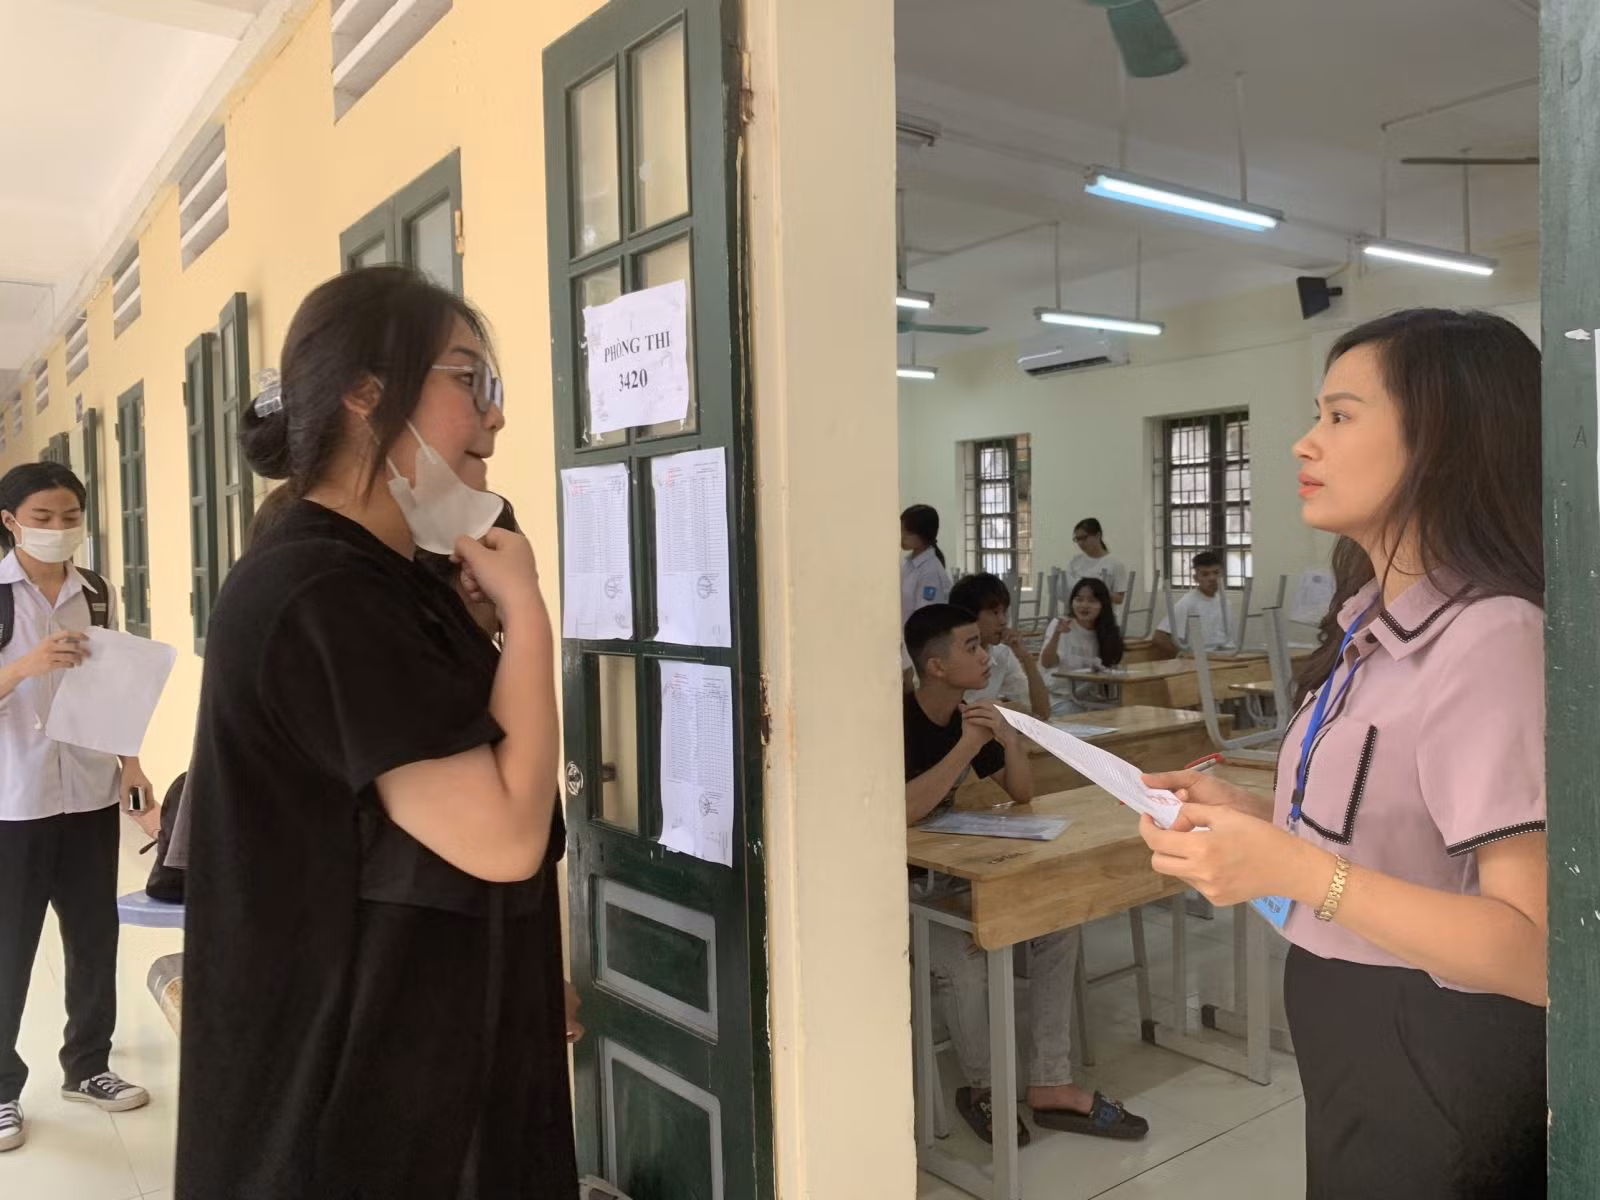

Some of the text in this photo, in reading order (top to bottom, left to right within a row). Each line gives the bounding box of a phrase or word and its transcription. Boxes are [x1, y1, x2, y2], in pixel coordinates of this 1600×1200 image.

[604, 331, 670, 363] PHÒNG THI
[619, 368, 648, 392] 3420
